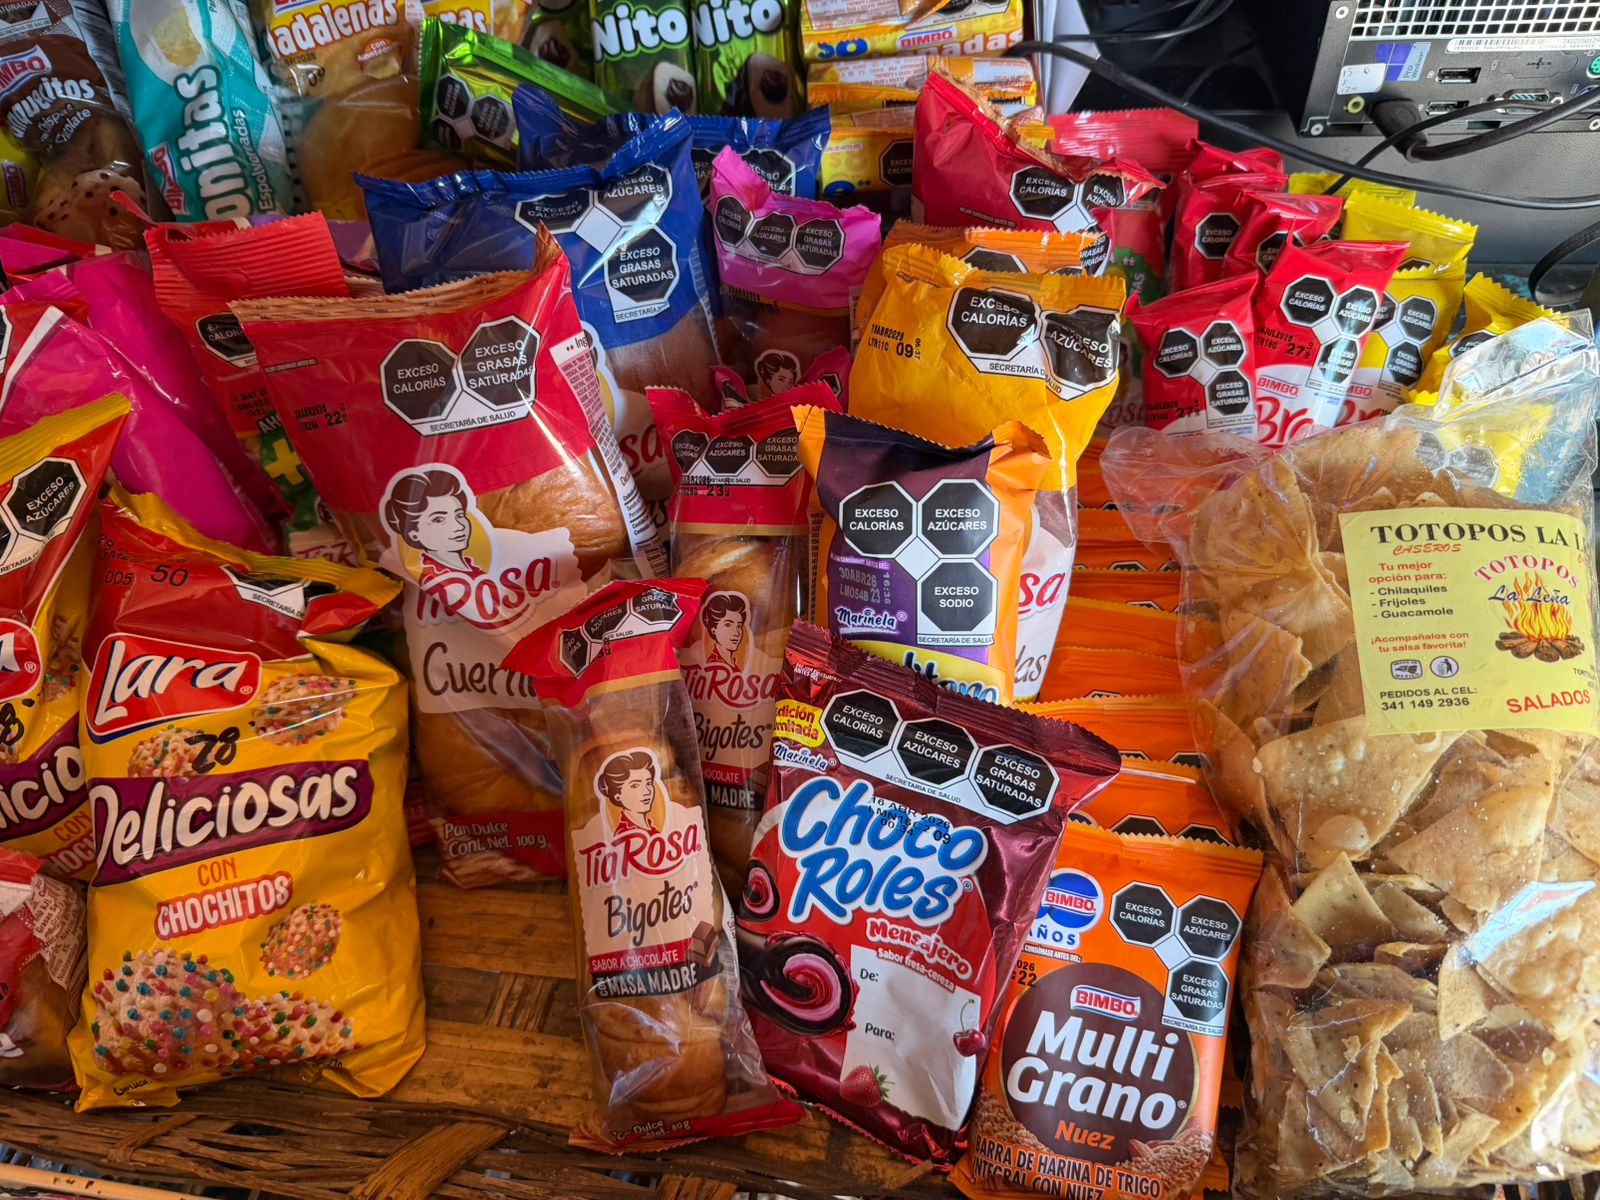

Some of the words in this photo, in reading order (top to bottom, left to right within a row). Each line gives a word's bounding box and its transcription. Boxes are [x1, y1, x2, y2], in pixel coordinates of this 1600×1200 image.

[692, 0, 783, 47] Nito
[592, 4, 688, 62] Nito
[901, 31, 953, 48] BIMBO
[176, 66, 251, 221] onitas
[1019, 185, 1067, 198] CALORÍAS
[803, 236, 833, 247] GRASAS
[805, 227, 833, 238] EXCESO
[620, 247, 660, 261] EXCESO
[797, 244, 838, 258] SATURADAS
[619, 260, 662, 273] GRASAS
[611, 270, 675, 288] SATURADAS
[1288, 299, 1327, 312] CALORÍAS
[1294, 291, 1325, 303] EXCESO
[960, 310, 1028, 328] CALORÍAS
[475, 340, 525, 358] EXCESO
[896, 342, 914, 358] 09
[1049, 331, 1112, 369] AZÚCARES
[1158, 351, 1193, 364] CALORÍAS
[1161, 344, 1189, 356] EXCESO
[1286, 342, 1304, 357] 27
[397, 363, 439, 380] EXCESO
[477, 354, 528, 372] GRASAS
[989, 363, 1038, 375] SECRETARÍA
[393, 376, 447, 394] CALORÍAS
[468, 366, 535, 390] SATURADAS
[1216, 382, 1243, 390] EXCESO
[1257, 377, 1299, 396] BIMBO
[1210, 397, 1250, 408] SATURADAS
[1216, 390, 1245, 399] GRASAS
[325, 411, 343, 427] 22
[430, 418, 477, 433] SECRETARÍA
[478, 417, 489, 425] DE
[489, 411, 516, 423] SALUD
[708, 447, 746, 457] AZÚCARES
[715, 441, 743, 449] EXCESO
[25, 481, 75, 524] AZÚCARES
[26, 476, 64, 511] EXCESO
[855, 508, 899, 518] EXCESO
[935, 508, 980, 518] EXCESO
[850, 519, 904, 531] CALORÍAS
[927, 518, 987, 531] AZÚCARES
[1371, 522, 1526, 543] TOTOPOS
[1535, 525, 1570, 547] LA
[1393, 543, 1462, 556] CASEROS
[1379, 562, 1394, 572] Tu
[1397, 561, 1433, 572] mejor
[1474, 554, 1579, 588] TOTOPOS
[151, 564, 189, 588] 50
[1369, 573, 1412, 585] opción
[1415, 573, 1447, 585] para:
[424, 556, 553, 630] Rosa
[870, 588, 881, 604] 23
[934, 586, 979, 596] EXCESO
[1378, 584, 1448, 597] Chilaquiles
[1488, 585, 1519, 602] La
[1526, 587, 1571, 605] Leña
[252, 592, 295, 615] SECRETARÍA
[939, 598, 974, 608] SODIO
[1379, 597, 1426, 609] Frijoles
[836, 607, 896, 628] Marinela
[1381, 607, 1454, 619] Guacamole
[918, 634, 958, 645] SECRETARÍA
[959, 636, 970, 645] DE
[1449, 631, 1469, 640] con
[1379, 645, 1390, 653] tu
[1391, 643, 1421, 652] salsa
[1423, 641, 1467, 651] favorita!
[93, 638, 249, 726] Lara
[1380, 688, 1431, 699] PEDIDOS
[1433, 687, 1449, 696] AL
[1451, 686, 1478, 695] CEL:
[1506, 690, 1591, 713] SALADOS
[1381, 701, 1404, 711] 341
[1410, 700, 1433, 709] 149
[1438, 698, 1470, 708] 2936
[842, 704, 884, 725] EXCESO
[832, 713, 884, 739] CALORÍAS
[914, 730, 958, 754] EXCESO
[774, 743, 828, 771] Marinela
[903, 739, 961, 769] AZÚCARES
[994, 755, 1040, 779] EXCESO
[885, 773, 927, 793] SECRETARÍA
[927, 788, 937, 797] DE
[937, 792, 962, 803] SALUD
[989, 766, 1037, 792] GRASAS
[711, 785, 755, 808] MADRE
[975, 774, 1043, 808] SATURADAS
[90, 766, 358, 868] Deliciosas
[782, 776, 984, 870] Choco
[445, 823, 471, 839] Pan
[473, 822, 509, 836] Dulce
[933, 830, 952, 845] 09
[516, 835, 537, 847] 100
[538, 835, 547, 848] g
[611, 824, 699, 877] Rosa
[197, 857, 237, 886] CON
[792, 848, 957, 919] Roles
[157, 874, 291, 936] CHOCHITOS
[1045, 890, 1096, 912] BIMBO
[1125, 902, 1162, 916] EXCESO
[604, 880, 694, 947] Bigotes
[1119, 910, 1165, 928] CALORÍAS
[1191, 915, 1228, 930] EXCESO
[1183, 924, 1232, 941] AZÚCARES
[869, 918, 971, 979] Mensajero
[592, 955, 618, 970] SABOR
[619, 957, 626, 968] A
[626, 949, 679, 967] CHOCOLATE
[860, 968, 879, 982] De:
[878, 948, 908, 965] Sabor
[905, 955, 955, 992] fresa-cereza
[1018, 970, 1037, 987] 22
[609, 973, 649, 996] MASA
[650, 963, 698, 993] MADRE
[1182, 974, 1219, 988] EXCESO
[1180, 984, 1218, 999] GRASAS
[1076, 989, 1138, 1016] BIMBO
[1171, 992, 1224, 1010] SATURADAS
[865, 1022, 895, 1041] Para:
[1163, 1017, 1198, 1032] SECRETARÍA
[1198, 1025, 1207, 1033] DE
[1025, 1010, 1180, 1083] Multi
[1007, 1055, 1177, 1130] Grano
[1054, 1119, 1117, 1151] Nuez
[973, 1159, 1028, 1188] INTEGRAL
[975, 1138, 1012, 1164] BARRA
[1015, 1147, 1035, 1173] DE
[1037, 1153, 1091, 1184] HARINA
[1095, 1164, 1114, 1189] DE
[1117, 1170, 1161, 1198] TRIGO
